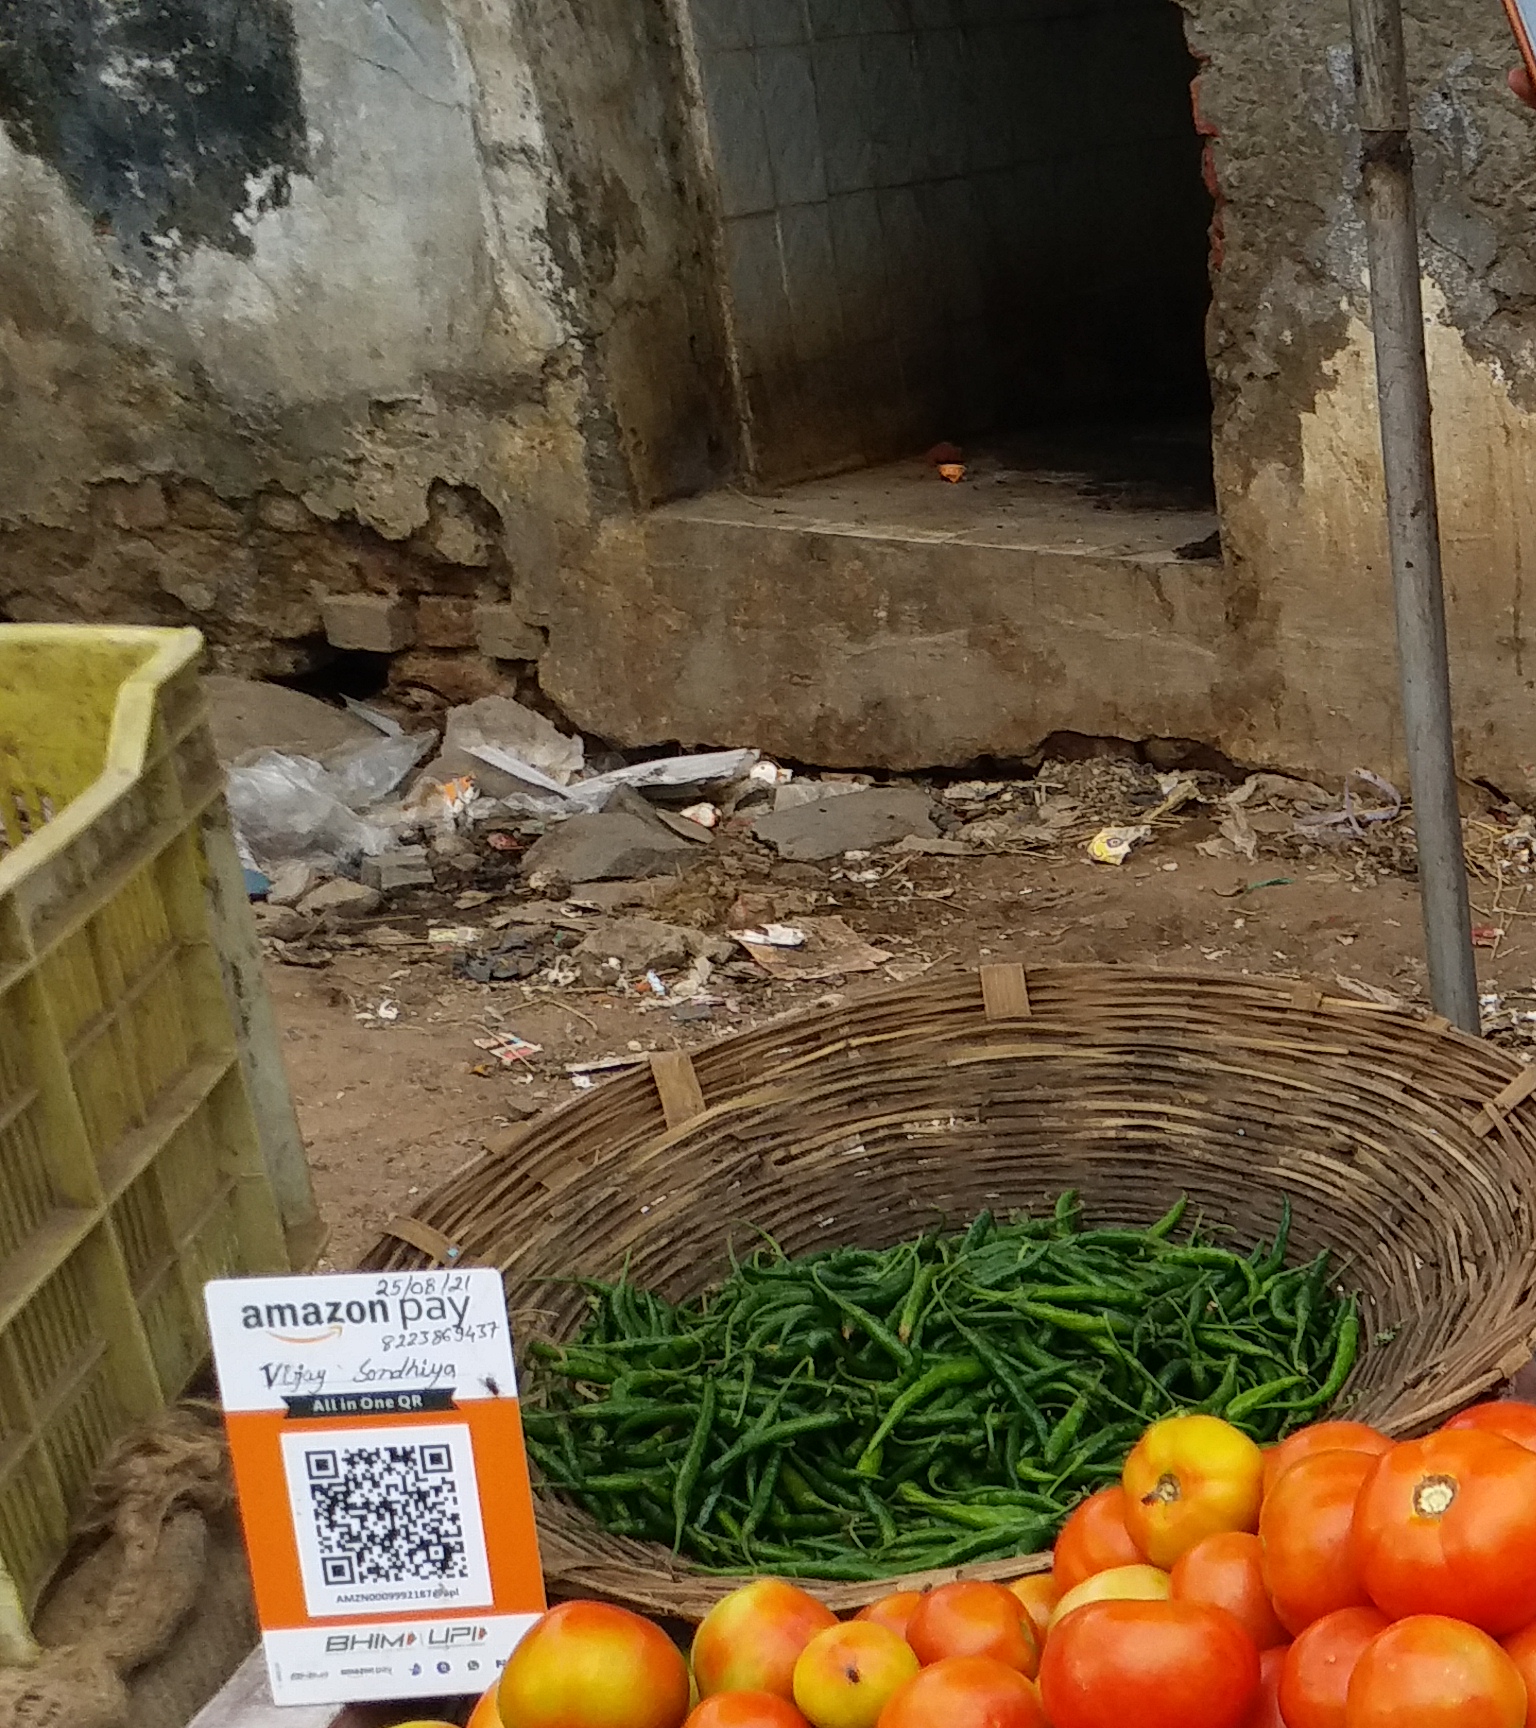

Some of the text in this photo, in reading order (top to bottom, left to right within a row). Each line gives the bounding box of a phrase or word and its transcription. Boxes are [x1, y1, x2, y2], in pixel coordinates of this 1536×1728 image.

[241, 1295, 471, 1330] amazon pay
[312, 1397, 339, 1413] All
[359, 1395, 395, 1411] One
[397, 1394, 424, 1409] QR
[325, 1625, 478, 1653] BHIM UPI
